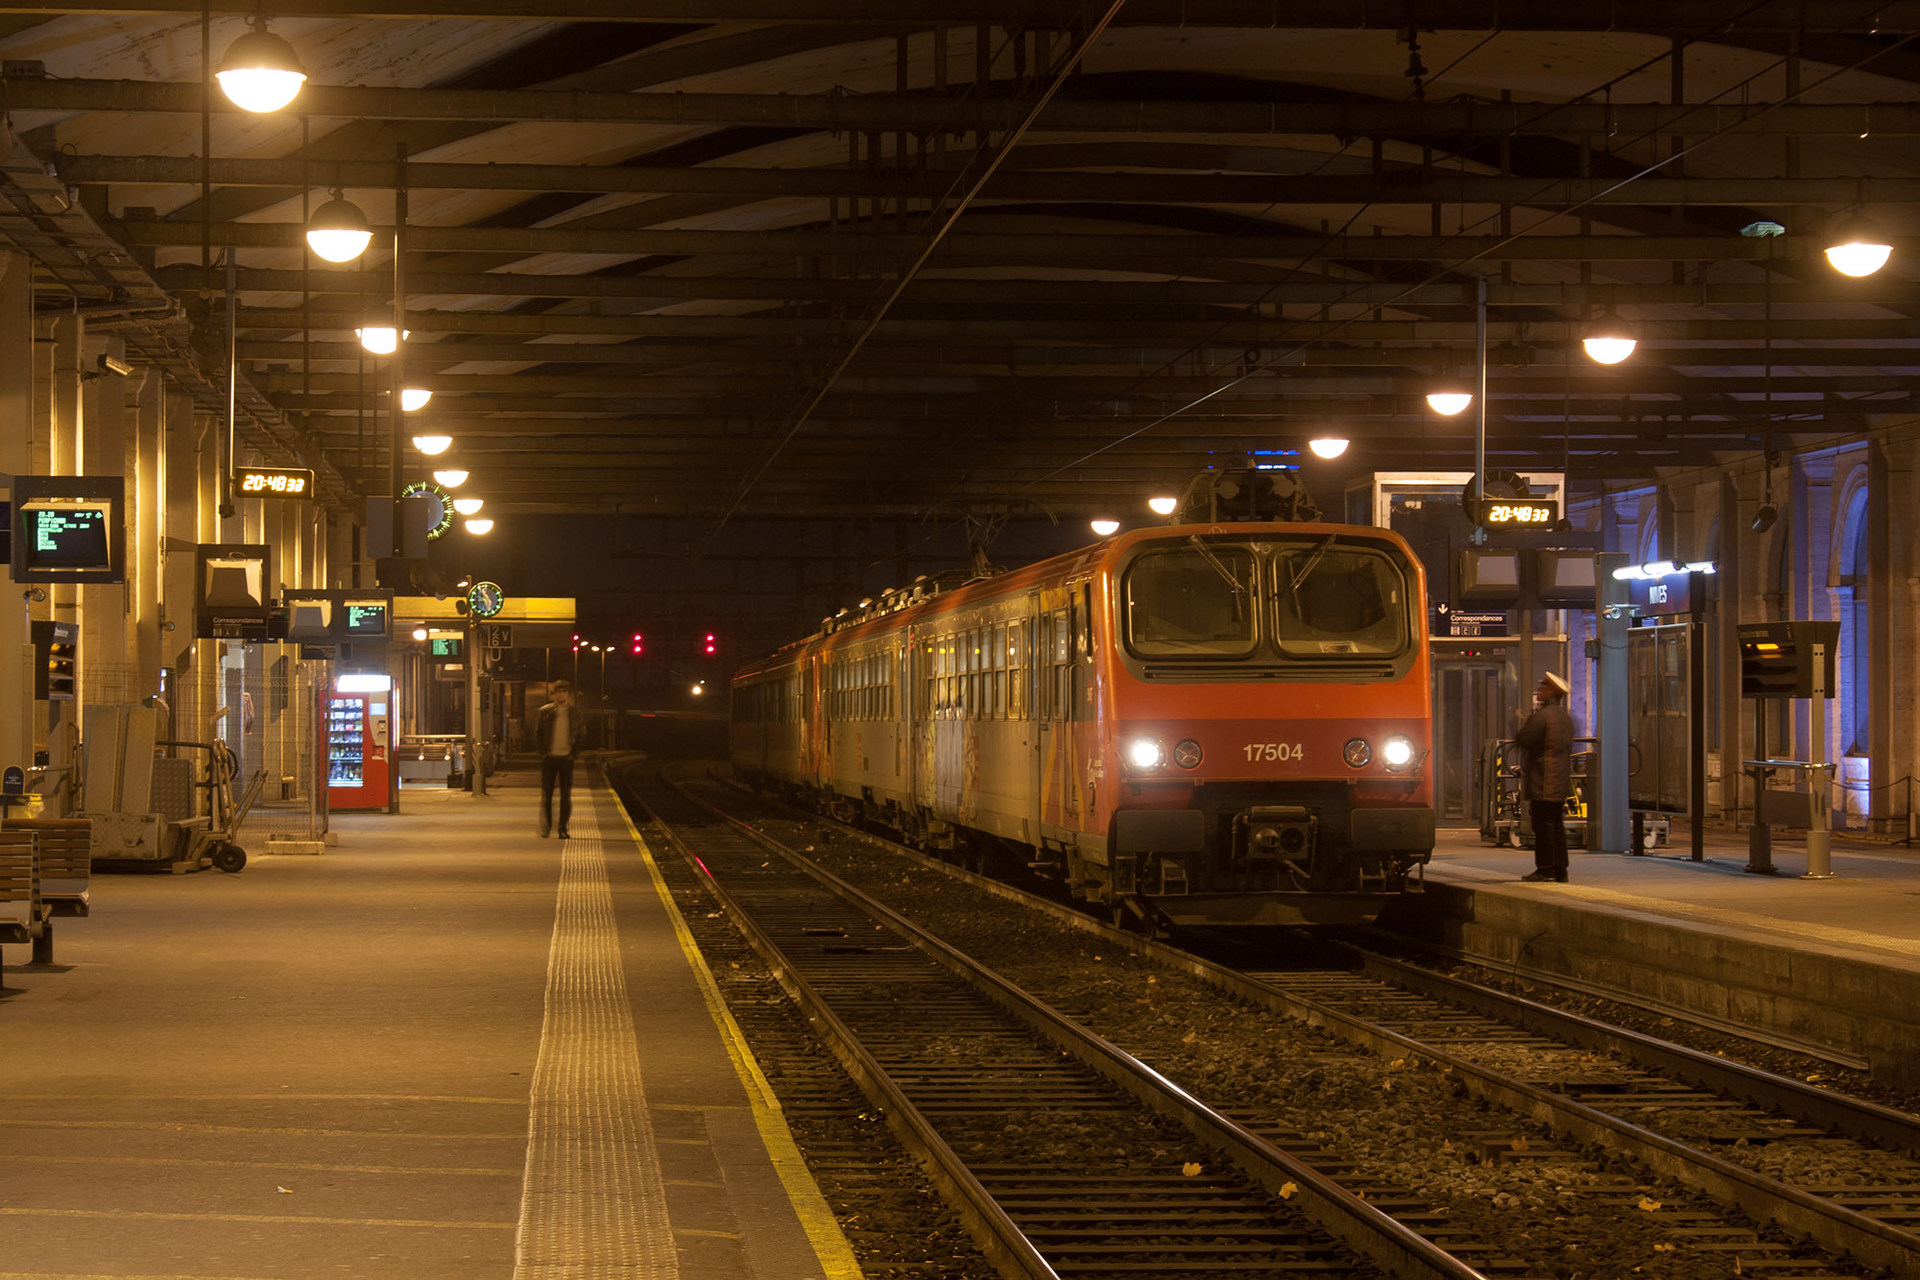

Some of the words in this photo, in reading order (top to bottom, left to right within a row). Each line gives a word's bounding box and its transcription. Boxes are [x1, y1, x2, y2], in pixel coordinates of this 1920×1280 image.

[243, 475, 287, 491] 20:48
[286, 479, 305, 492] 32
[1490, 506, 1533, 522] 20:48
[1532, 509, 1550, 522] 32
[1450, 614, 1503, 622] Correspondances
[1243, 743, 1304, 761] 17504
